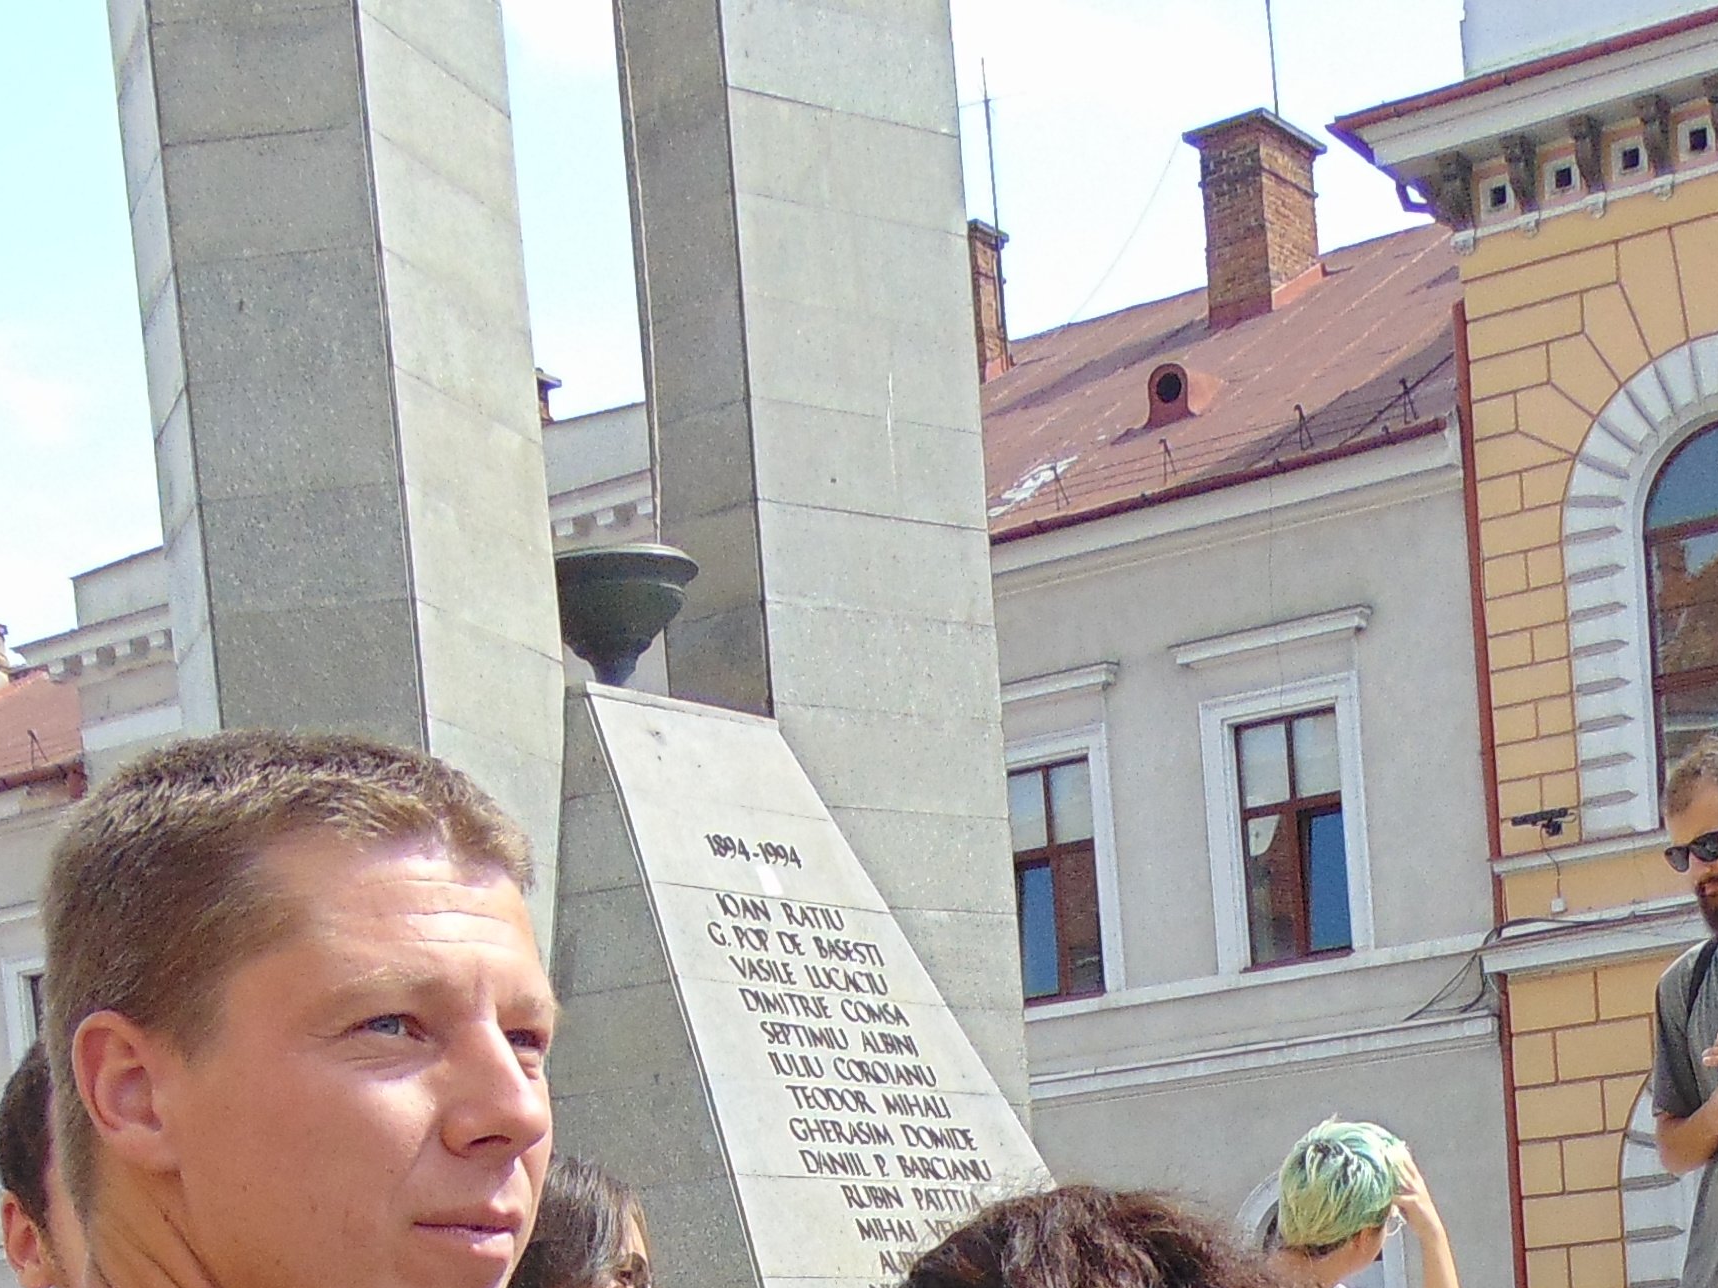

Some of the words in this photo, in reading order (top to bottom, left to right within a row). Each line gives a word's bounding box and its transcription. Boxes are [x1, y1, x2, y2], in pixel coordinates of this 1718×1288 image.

[704, 834, 802, 869] 1894-1994
[715, 892, 772, 922] IOAN
[780, 902, 845, 931] RATIU
[776, 931, 806, 956] DE
[729, 955, 797, 985] VASILE
[804, 964, 888, 996] LUCACIU
[739, 988, 832, 1019] DIMITRIE
[840, 999, 910, 1027] COMSA
[760, 1021, 849, 1050] SEPTIMIU
[861, 1030, 919, 1057] ALBINI
[767, 1052, 824, 1078] IULIU
[833, 1057, 937, 1088] COROIANU
[785, 1085, 877, 1114] TEODOR
[881, 1093, 952, 1119] MIHALI
[789, 1118, 895, 1146] GHERASIM
[899, 1124, 978, 1151] DOMIDE
[799, 1149, 871, 1177] DANIIL
[896, 1154, 992, 1182] BARCIANU
[840, 1184, 904, 1209] RUBIN
[855, 1218, 918, 1243] MIHAI
